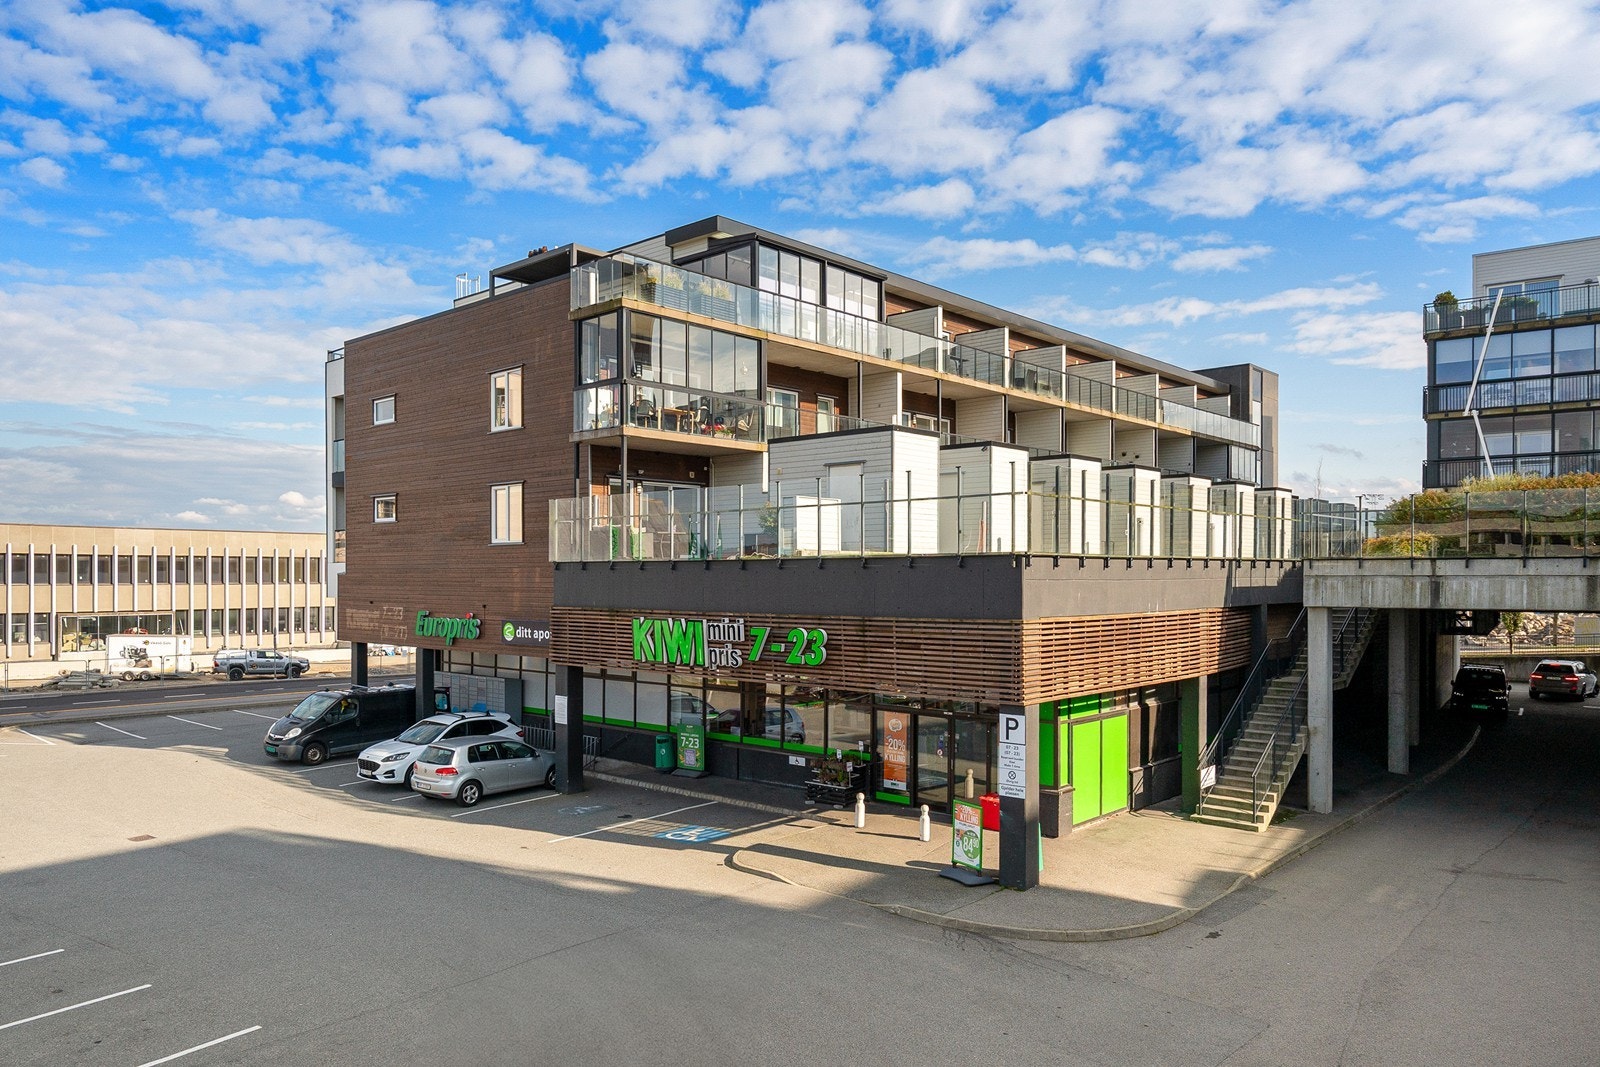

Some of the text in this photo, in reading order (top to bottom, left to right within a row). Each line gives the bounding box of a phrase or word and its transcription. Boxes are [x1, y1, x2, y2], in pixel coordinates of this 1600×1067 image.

[415, 610, 482, 646] Europris
[515, 626, 552, 642] ditt apo
[707, 618, 744, 641] mini
[632, 617, 706, 666] KIWI
[707, 643, 743, 670] pris
[1005, 717, 1019, 740] P
[884, 752, 906, 763] KYLLING
